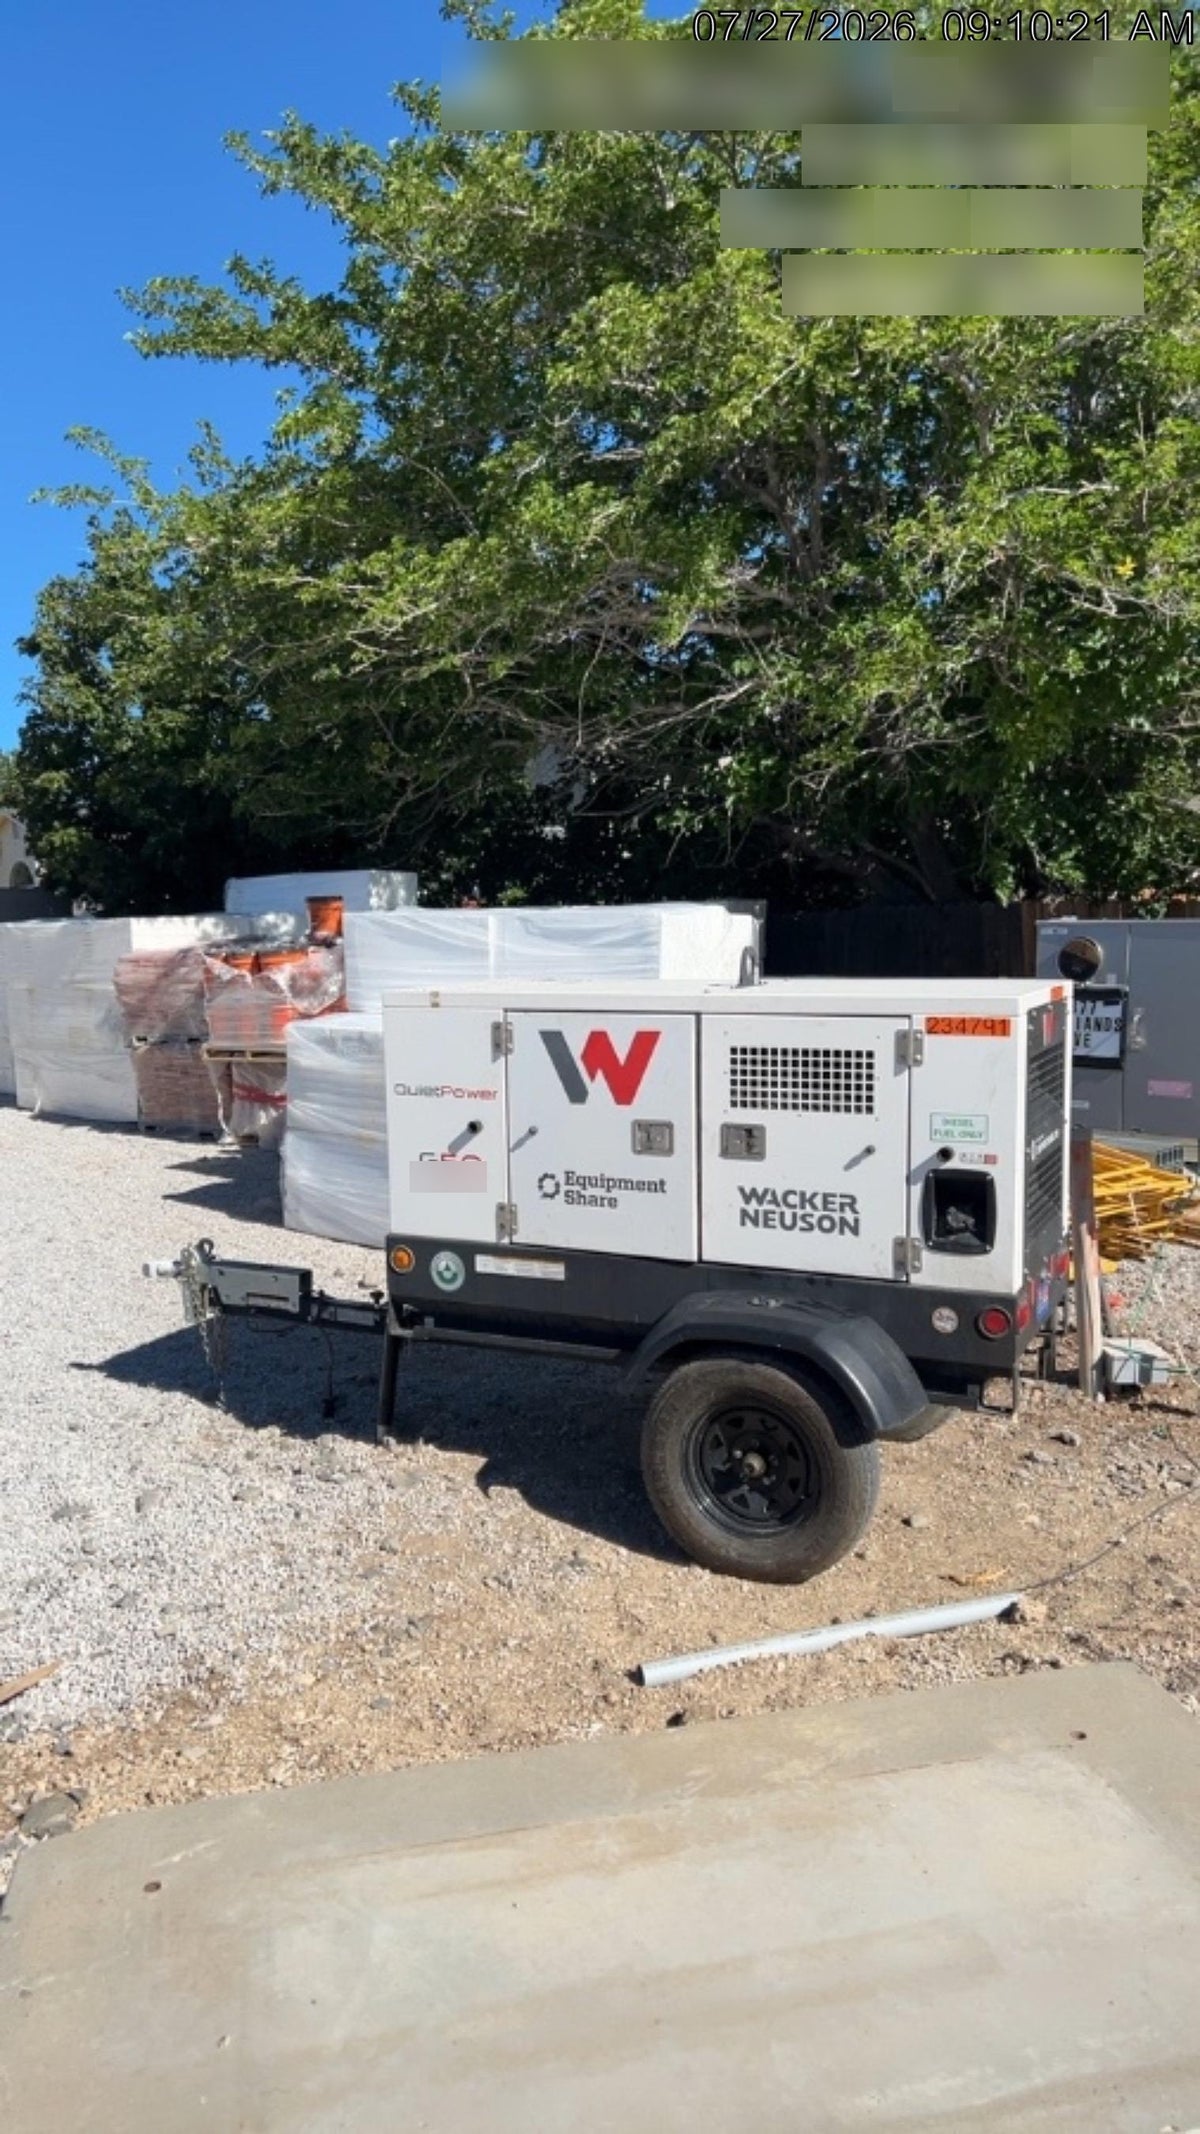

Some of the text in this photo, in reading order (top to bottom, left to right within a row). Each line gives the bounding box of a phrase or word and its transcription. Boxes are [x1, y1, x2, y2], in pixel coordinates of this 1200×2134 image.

[926, 1017, 1009, 1037] 234791
[393, 1083, 498, 1101] QuietPower
[563, 1170, 667, 1194] Equipment
[563, 1189, 618, 1209] Share
[737, 1185, 860, 1215] WACKER
[739, 1207, 860, 1237] NEUSON
